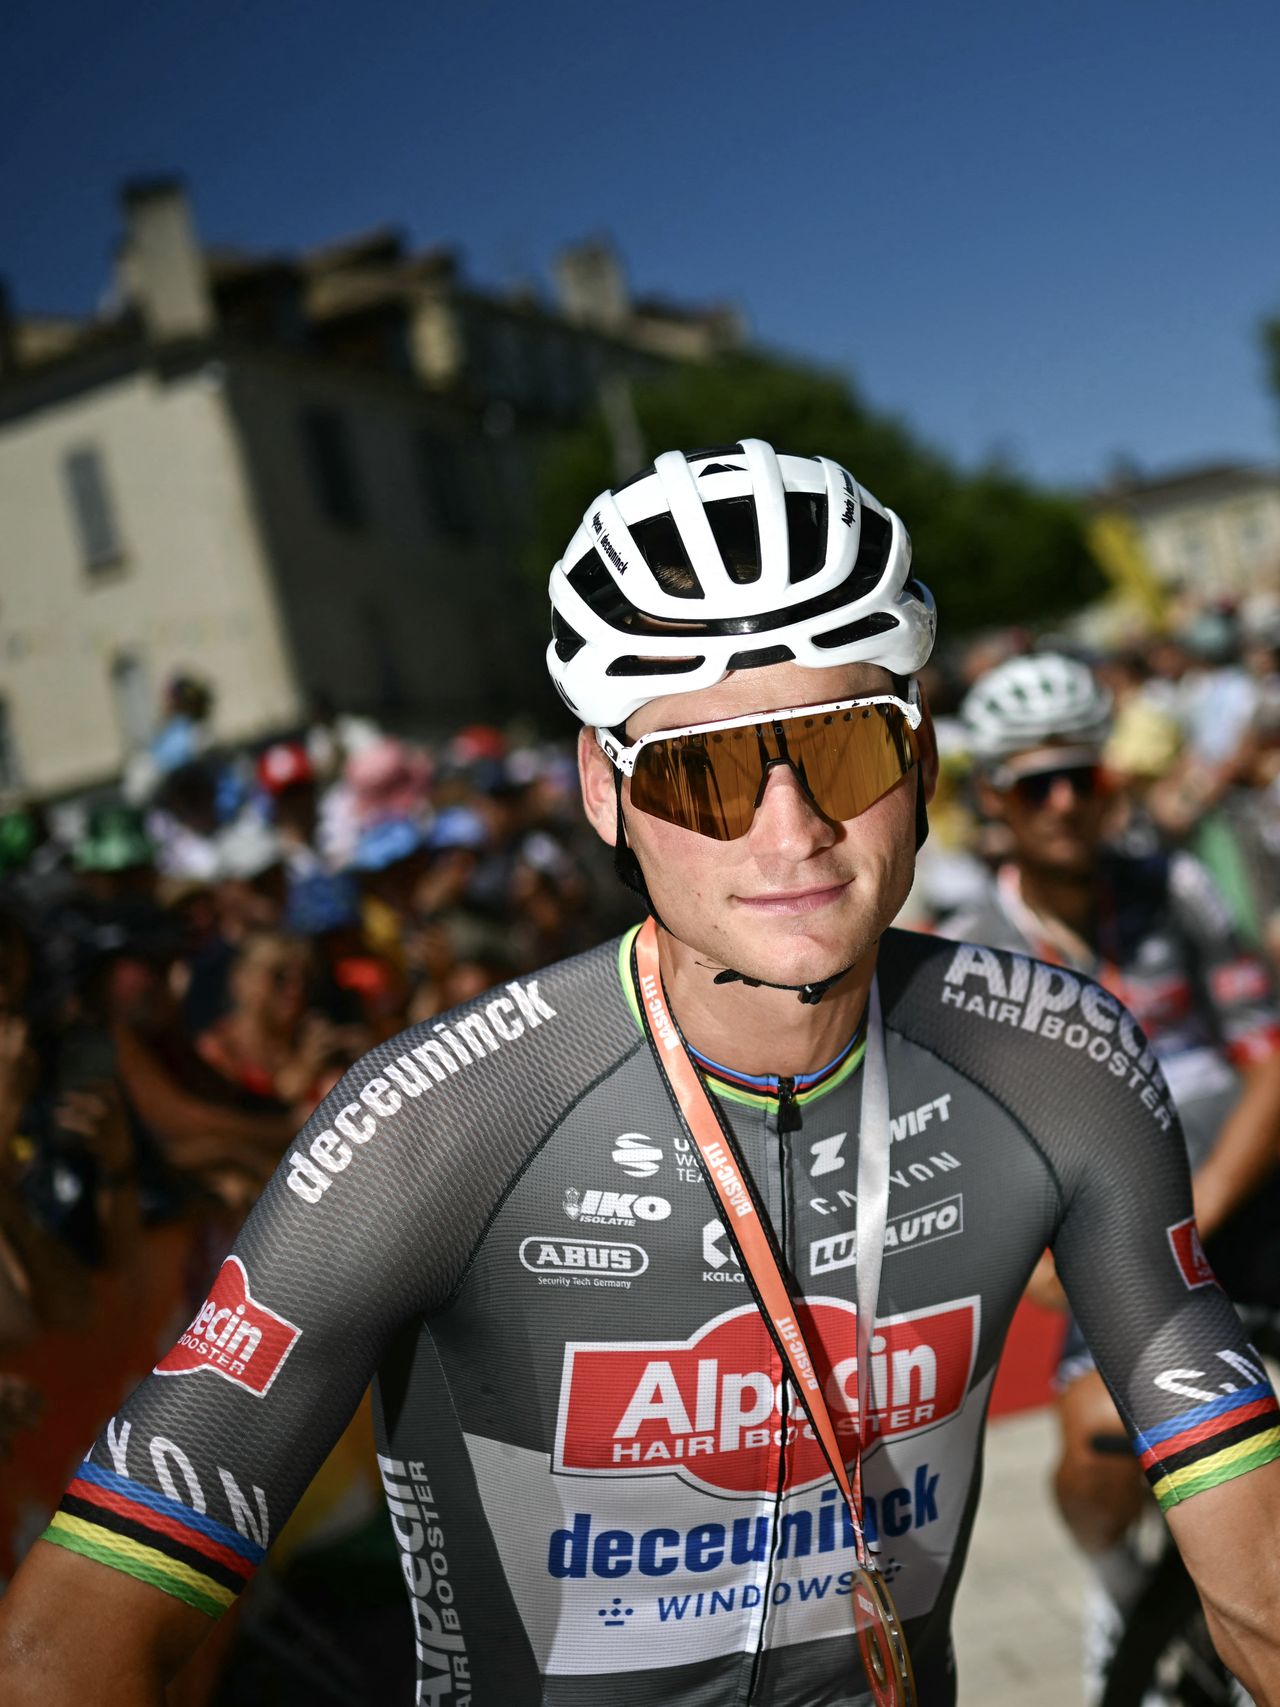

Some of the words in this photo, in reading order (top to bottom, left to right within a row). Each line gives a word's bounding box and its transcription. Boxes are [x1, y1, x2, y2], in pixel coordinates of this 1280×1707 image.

[600, 533, 628, 575] deceuninck
[641, 974, 680, 1051] BASIC-FIT
[944, 943, 1180, 1116] Alpec
[941, 986, 1021, 1027] HAIR
[1040, 1014, 1172, 1131] BOOSTER
[286, 980, 557, 1205] deceuninck
[580, 1190, 672, 1221] IKO
[703, 1142, 753, 1218] BASIC-FIT
[810, 1151, 962, 1216] CAYON
[579, 1215, 637, 1227] ISOLATIE
[814, 1204, 959, 1268] LUAUTO
[536, 1244, 632, 1270] ABUS
[538, 1276, 571, 1287] Security
[572, 1277, 591, 1286] Tech
[593, 1278, 632, 1289] Germany
[775, 1316, 819, 1391] BASIC-FIT
[612, 1436, 716, 1463] HAIR
[547, 1464, 940, 1579] deceuninck
[408, 1460, 462, 1631] BOOSTER
[450, 1655, 472, 1707] AIR
[657, 1571, 857, 1622] WINDOWS
